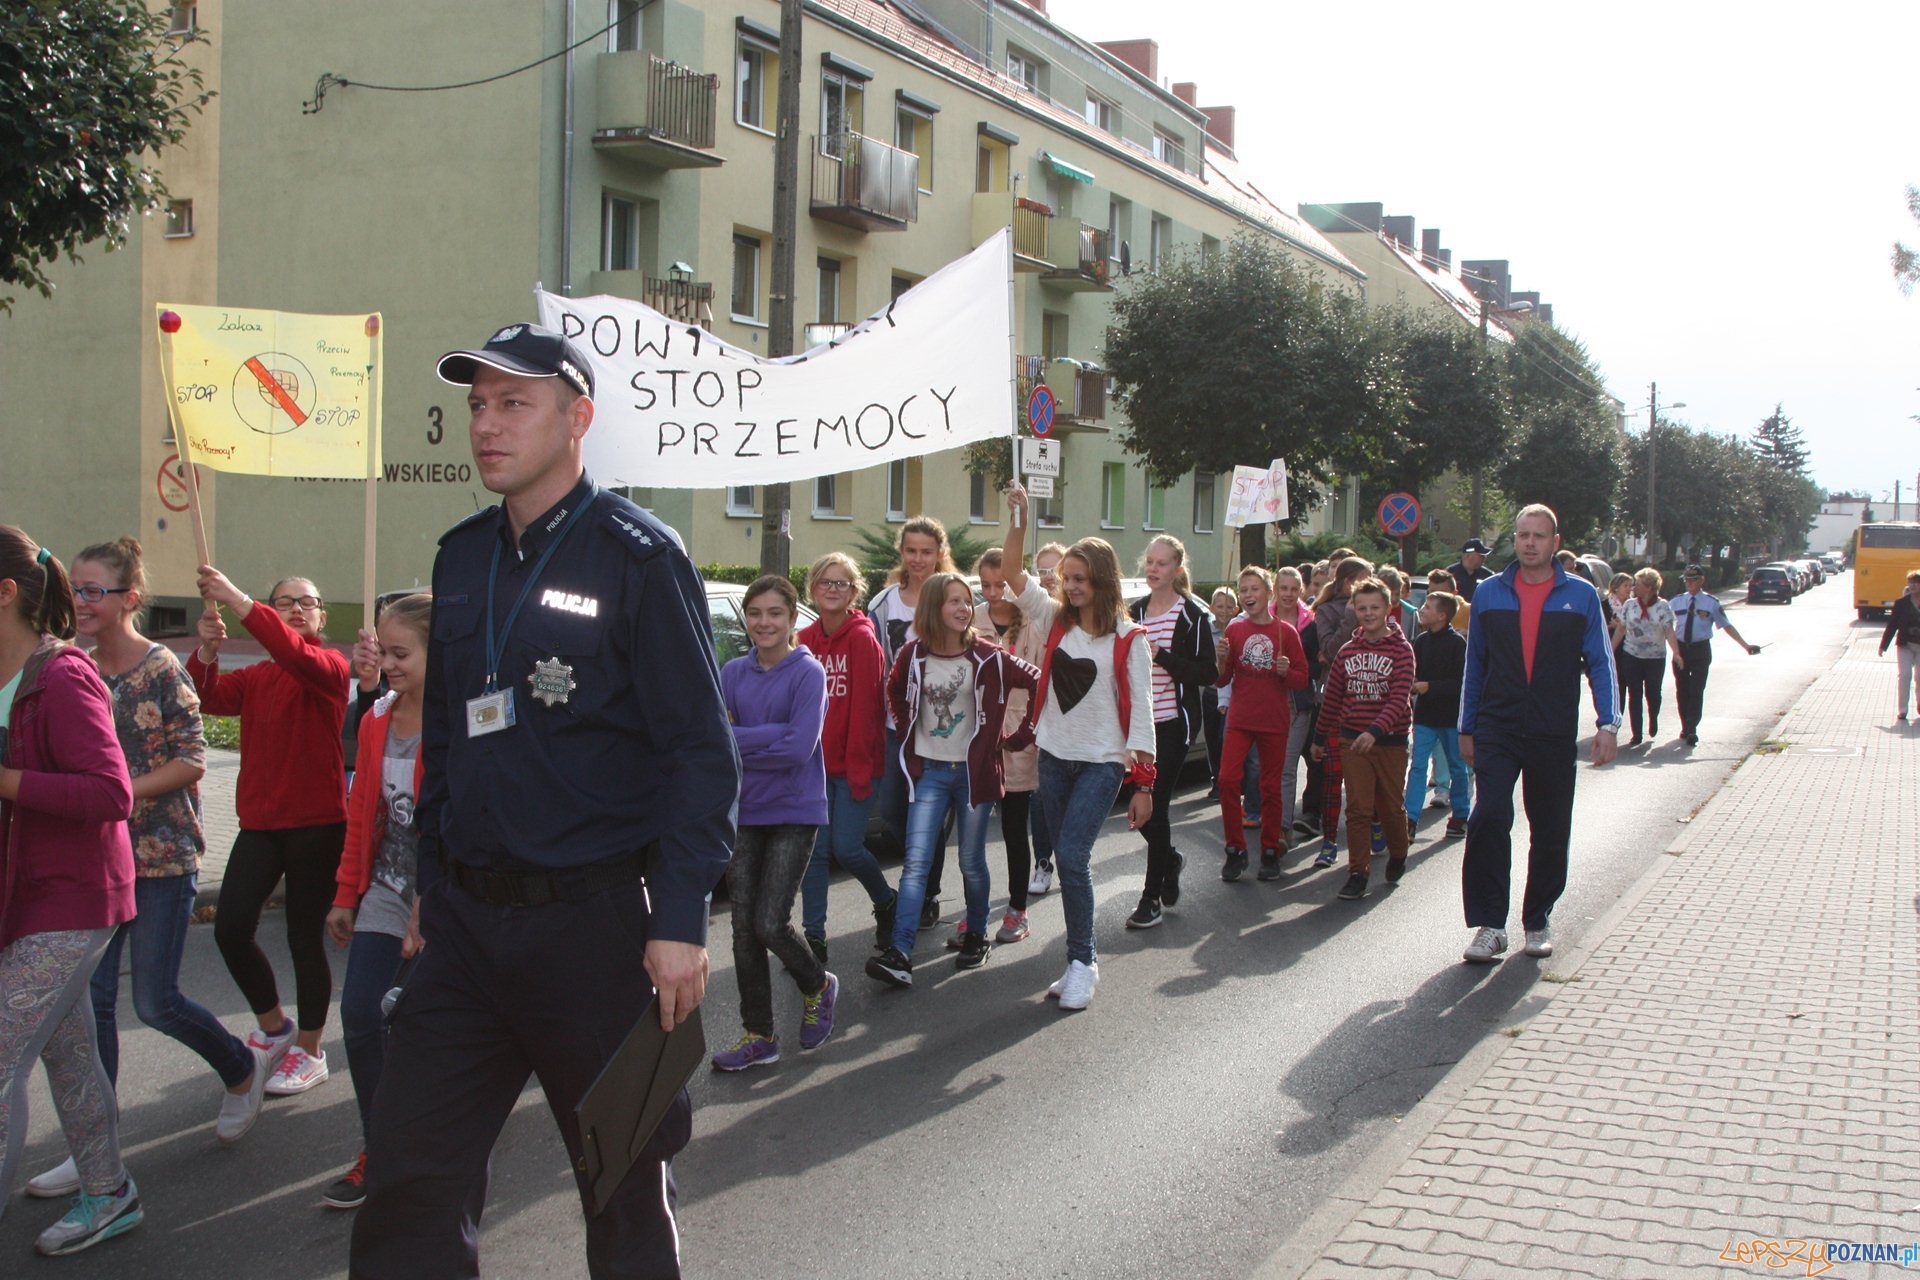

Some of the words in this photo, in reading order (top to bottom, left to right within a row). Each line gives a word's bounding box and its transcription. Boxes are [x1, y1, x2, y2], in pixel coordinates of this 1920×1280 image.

[217, 313, 263, 332] Zakaz
[316, 339, 351, 355] Przeciw
[176, 383, 218, 405] STOP
[630, 367, 763, 413] STOP
[314, 405, 361, 427] STOP
[426, 405, 444, 445] 3
[657, 385, 958, 458] PRZEMOCY
[1025, 459, 1042, 470] Strefa
[1043, 462, 1058, 473] ruchu
[546, 508, 568, 533] POLICJA
[540, 589, 599, 617] POLICJA
